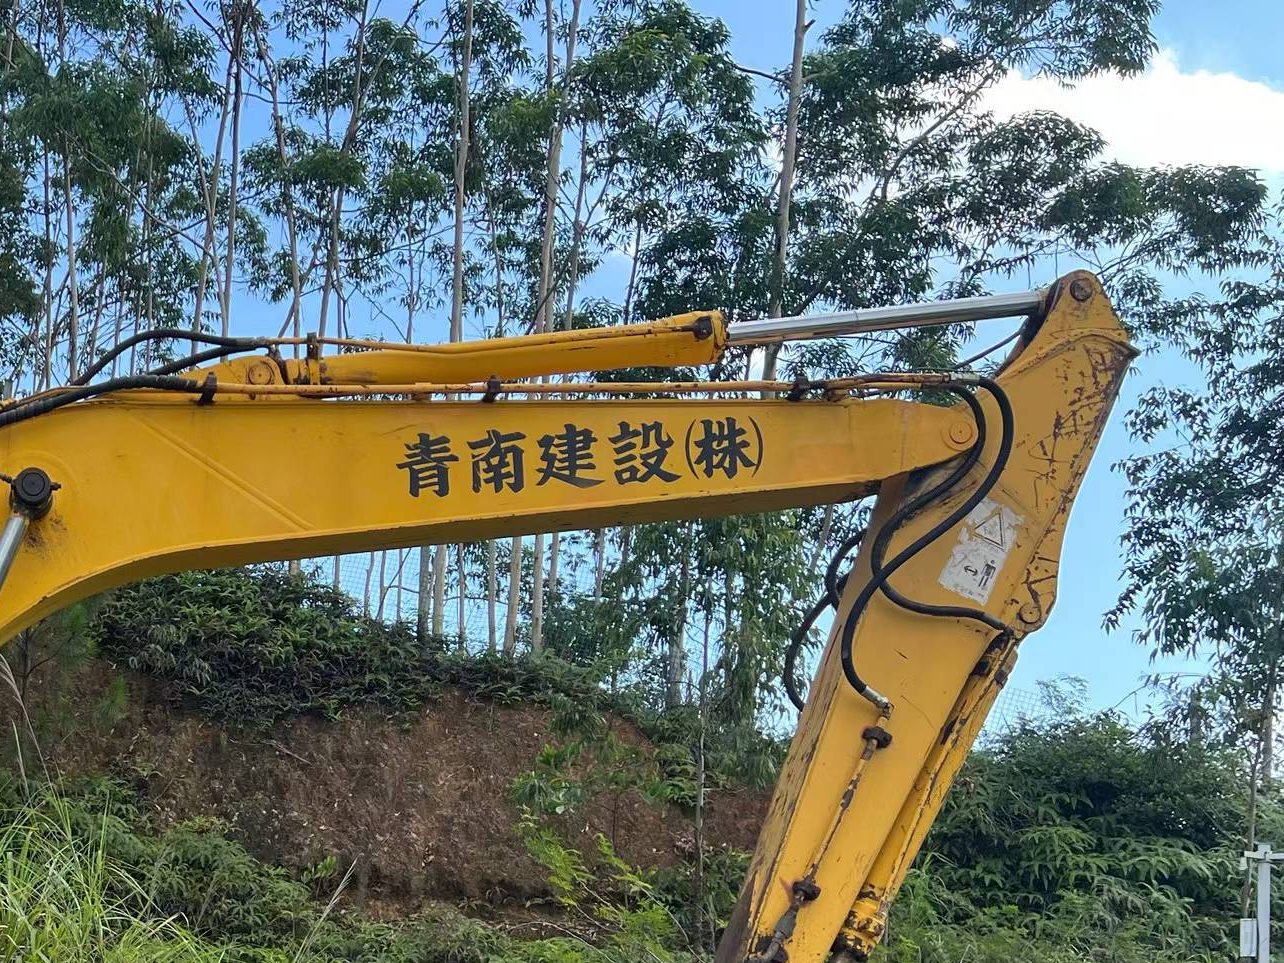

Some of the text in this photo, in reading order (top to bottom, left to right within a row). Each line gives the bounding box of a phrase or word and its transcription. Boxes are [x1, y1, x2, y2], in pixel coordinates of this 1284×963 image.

[395, 415, 765, 499] 青南建設(株)
